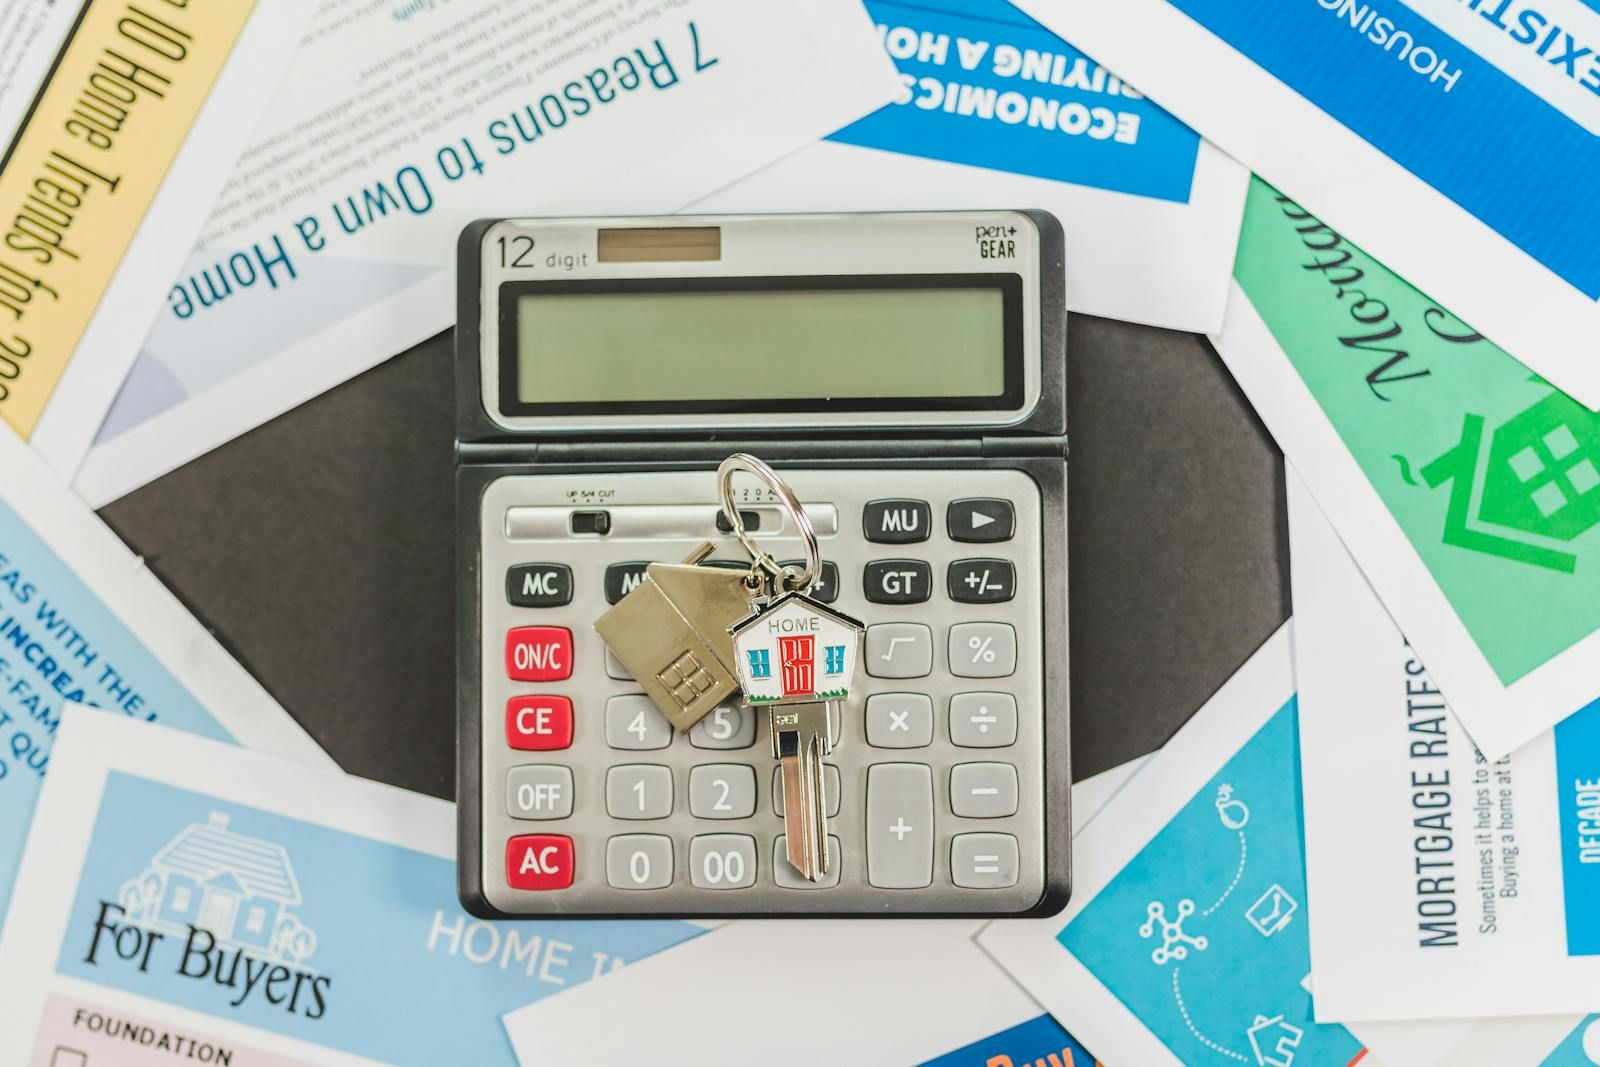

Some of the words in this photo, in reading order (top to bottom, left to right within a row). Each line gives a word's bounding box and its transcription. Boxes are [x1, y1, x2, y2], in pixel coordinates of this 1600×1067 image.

[117, 5, 195, 62] 10
[688, 21, 719, 72] 7
[876, 23, 950, 65] HO
[1468, 0, 1600, 97] EXIST
[956, 37, 990, 70] A
[65, 49, 172, 151] Home
[488, 39, 680, 155] Reasons
[896, 73, 1141, 145] ECONOMICS
[436, 137, 485, 181] to
[5, 150, 122, 265] Trends
[332, 165, 435, 235] Own
[295, 217, 327, 252] a
[980, 240, 1016, 259] GEAR
[498, 235, 535, 268] 12
[545, 252, 588, 271] digit
[168, 234, 299, 319] Home
[566, 490, 578, 498] UP
[881, 509, 919, 532] MU
[522, 572, 558, 596] MC
[882, 570, 917, 595] GT
[768, 617, 821, 633] HOME
[0, 616, 101, 708] INCREA
[36, 600, 99, 669] WITH
[98, 663, 145, 717] THE
[514, 643, 561, 670] ON/C
[969, 636, 996, 663] %
[516, 707, 553, 735] CE
[627, 711, 648, 742] 4
[712, 707, 733, 739] 5
[10, 731, 50, 778] QU
[1472, 769, 1489, 785] to
[1494, 771, 1512, 785] at
[518, 783, 562, 811] OFF
[632, 780, 645, 811] 1
[711, 779, 733, 811] 2
[1473, 788, 1493, 830] helps
[1497, 789, 1515, 831] home
[1474, 833, 1493, 845] it
[1502, 834, 1515, 844] a
[518, 846, 560, 874] AC
[629, 851, 650, 883] 0
[703, 851, 744, 883] 00
[1411, 769, 1459, 949] MORTGAGE
[1499, 846, 1519, 899] Buying
[1479, 848, 1498, 934] Sometimes
[82, 900, 165, 976] For
[177, 923, 333, 1020] Buyers
[427, 908, 574, 985] HOME
[72, 1008, 233, 1067] FOUNDATION
